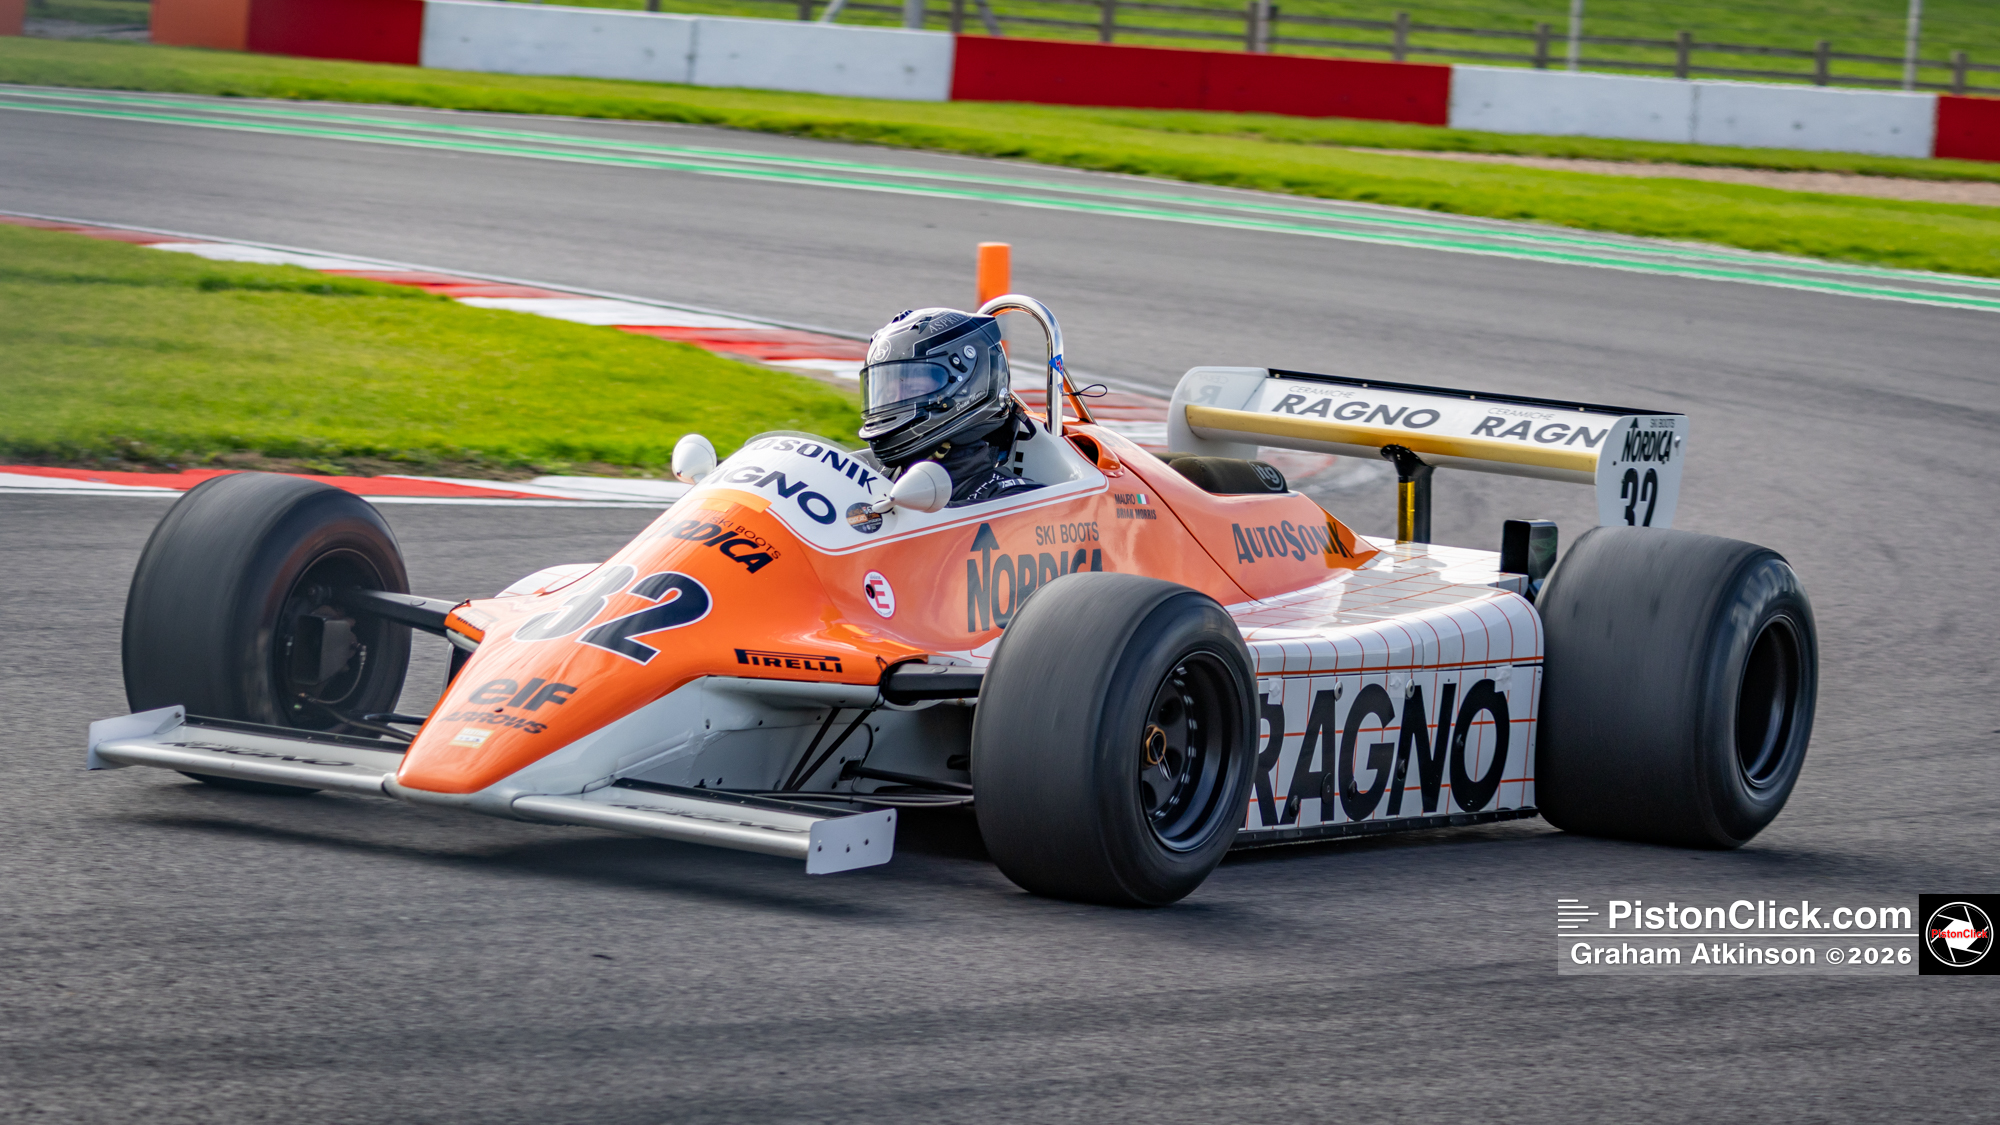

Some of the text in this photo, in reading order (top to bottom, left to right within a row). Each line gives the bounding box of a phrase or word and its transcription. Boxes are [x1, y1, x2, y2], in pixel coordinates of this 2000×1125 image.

[1289, 385, 1355, 398] CERAMICHE
[1271, 393, 1441, 429] RAGNO
[1488, 407, 1556, 420] CERAMICHE
[1470, 415, 1609, 448] RAGN
[1621, 430, 1673, 462] NORDICA
[1114, 493, 1136, 505] MAURO
[1620, 467, 1658, 527] 32
[1116, 508, 1157, 520] BRIAN MORRIS
[709, 516, 781, 560] SKI BOOTS
[1035, 521, 1100, 546] SKI BOOTS
[511, 564, 713, 666] 32
[734, 648, 843, 673] PIRELLI
[468, 677, 578, 711] elf
[1241, 678, 1510, 826] RAGNO
